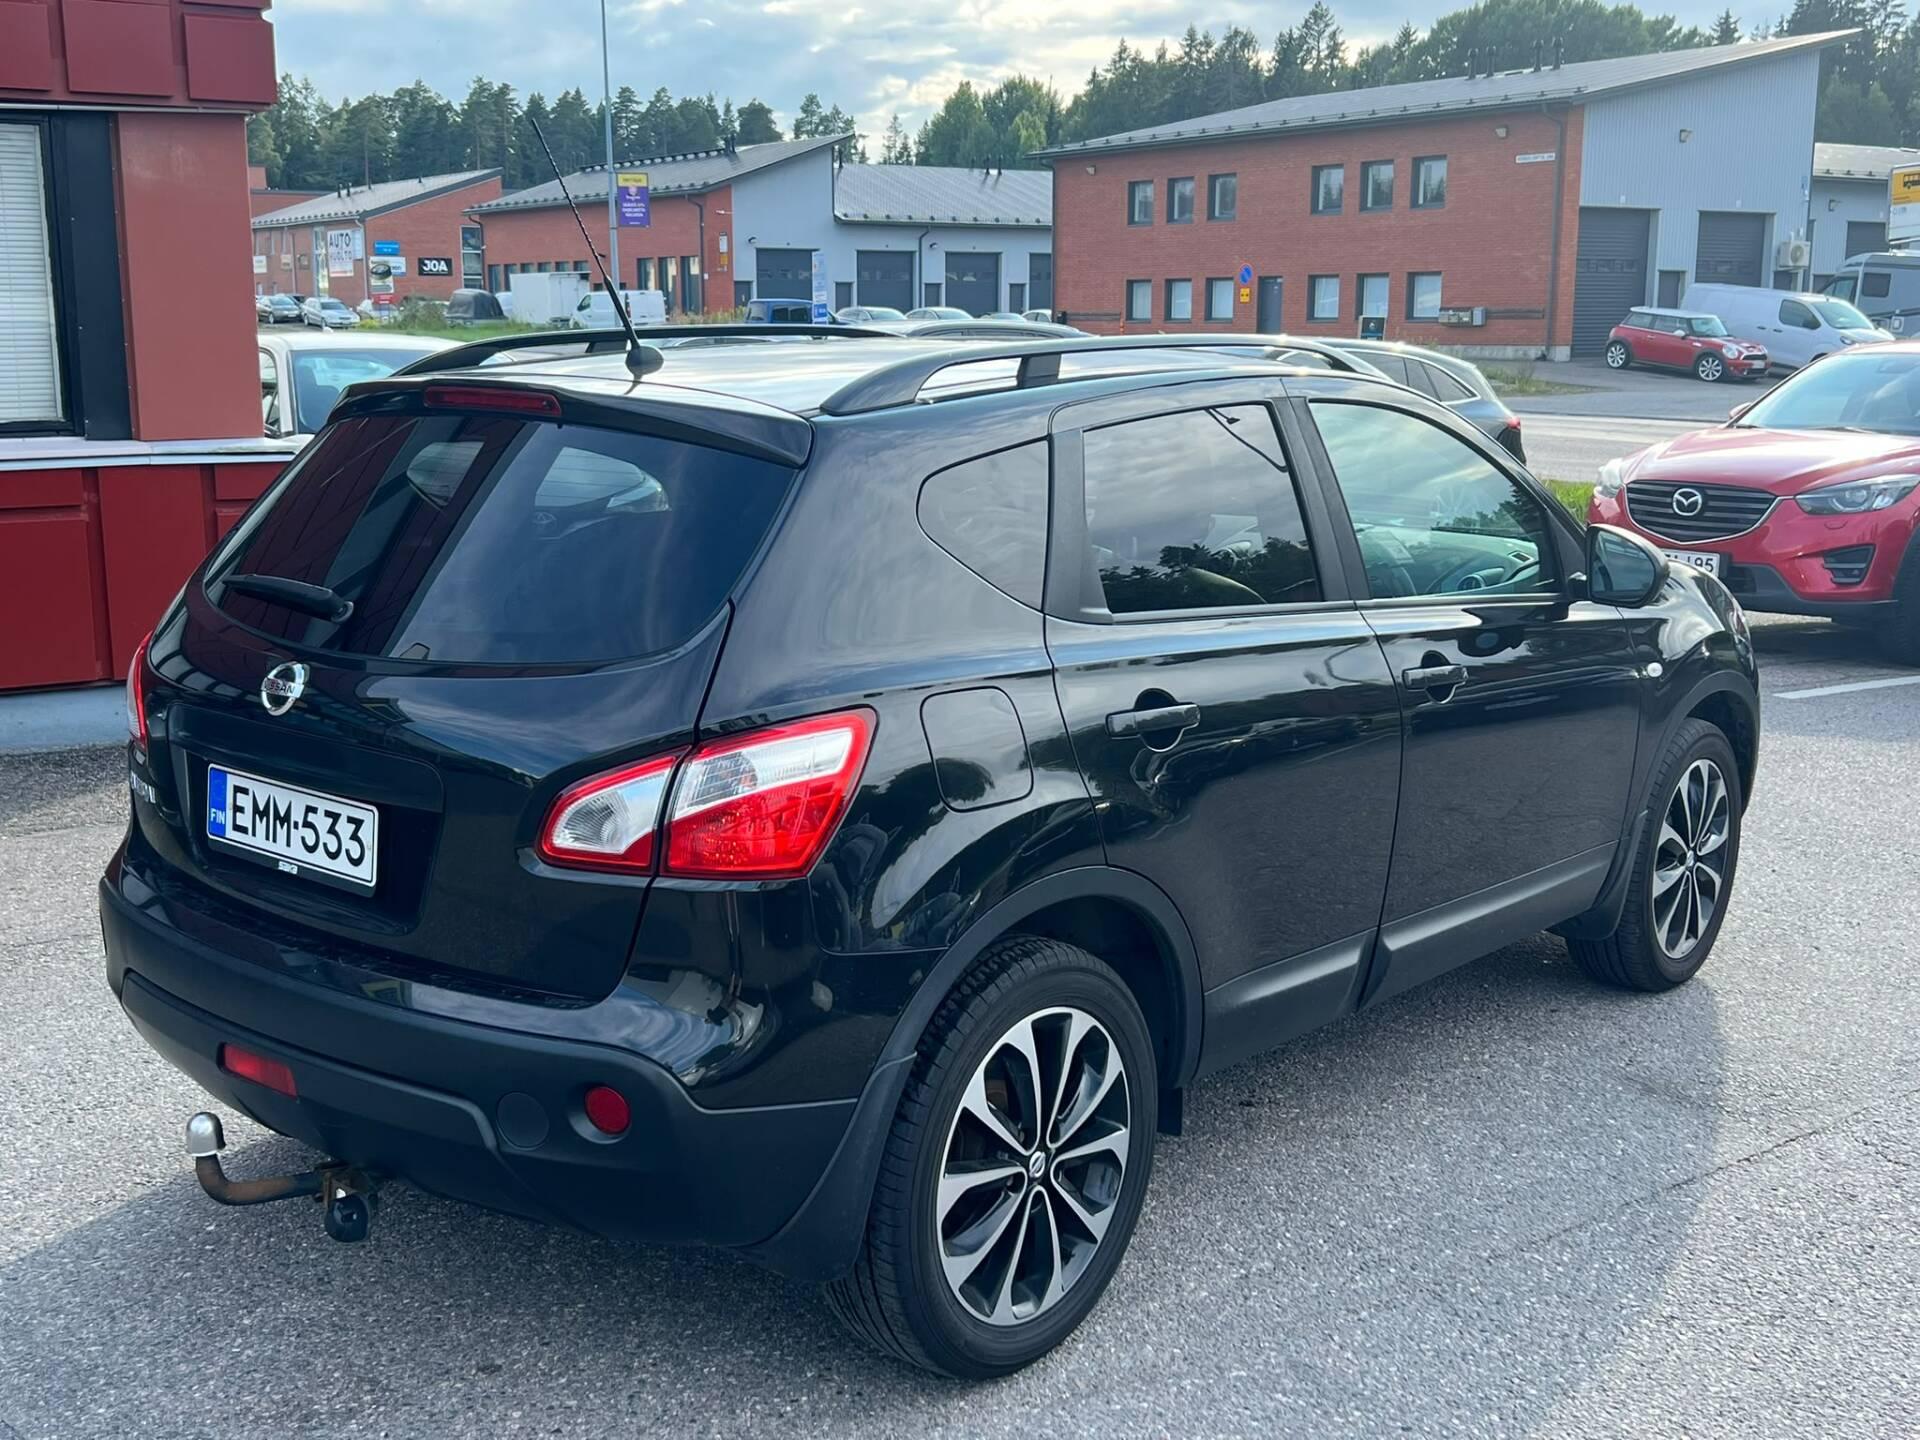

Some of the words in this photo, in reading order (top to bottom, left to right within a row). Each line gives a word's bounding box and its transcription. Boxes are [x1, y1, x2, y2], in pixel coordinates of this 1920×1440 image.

[329, 231, 351, 248] AUTO
[422, 260, 448, 272] JOA
[210, 808, 226, 825] FIN
[232, 784, 366, 867] EMM-533
